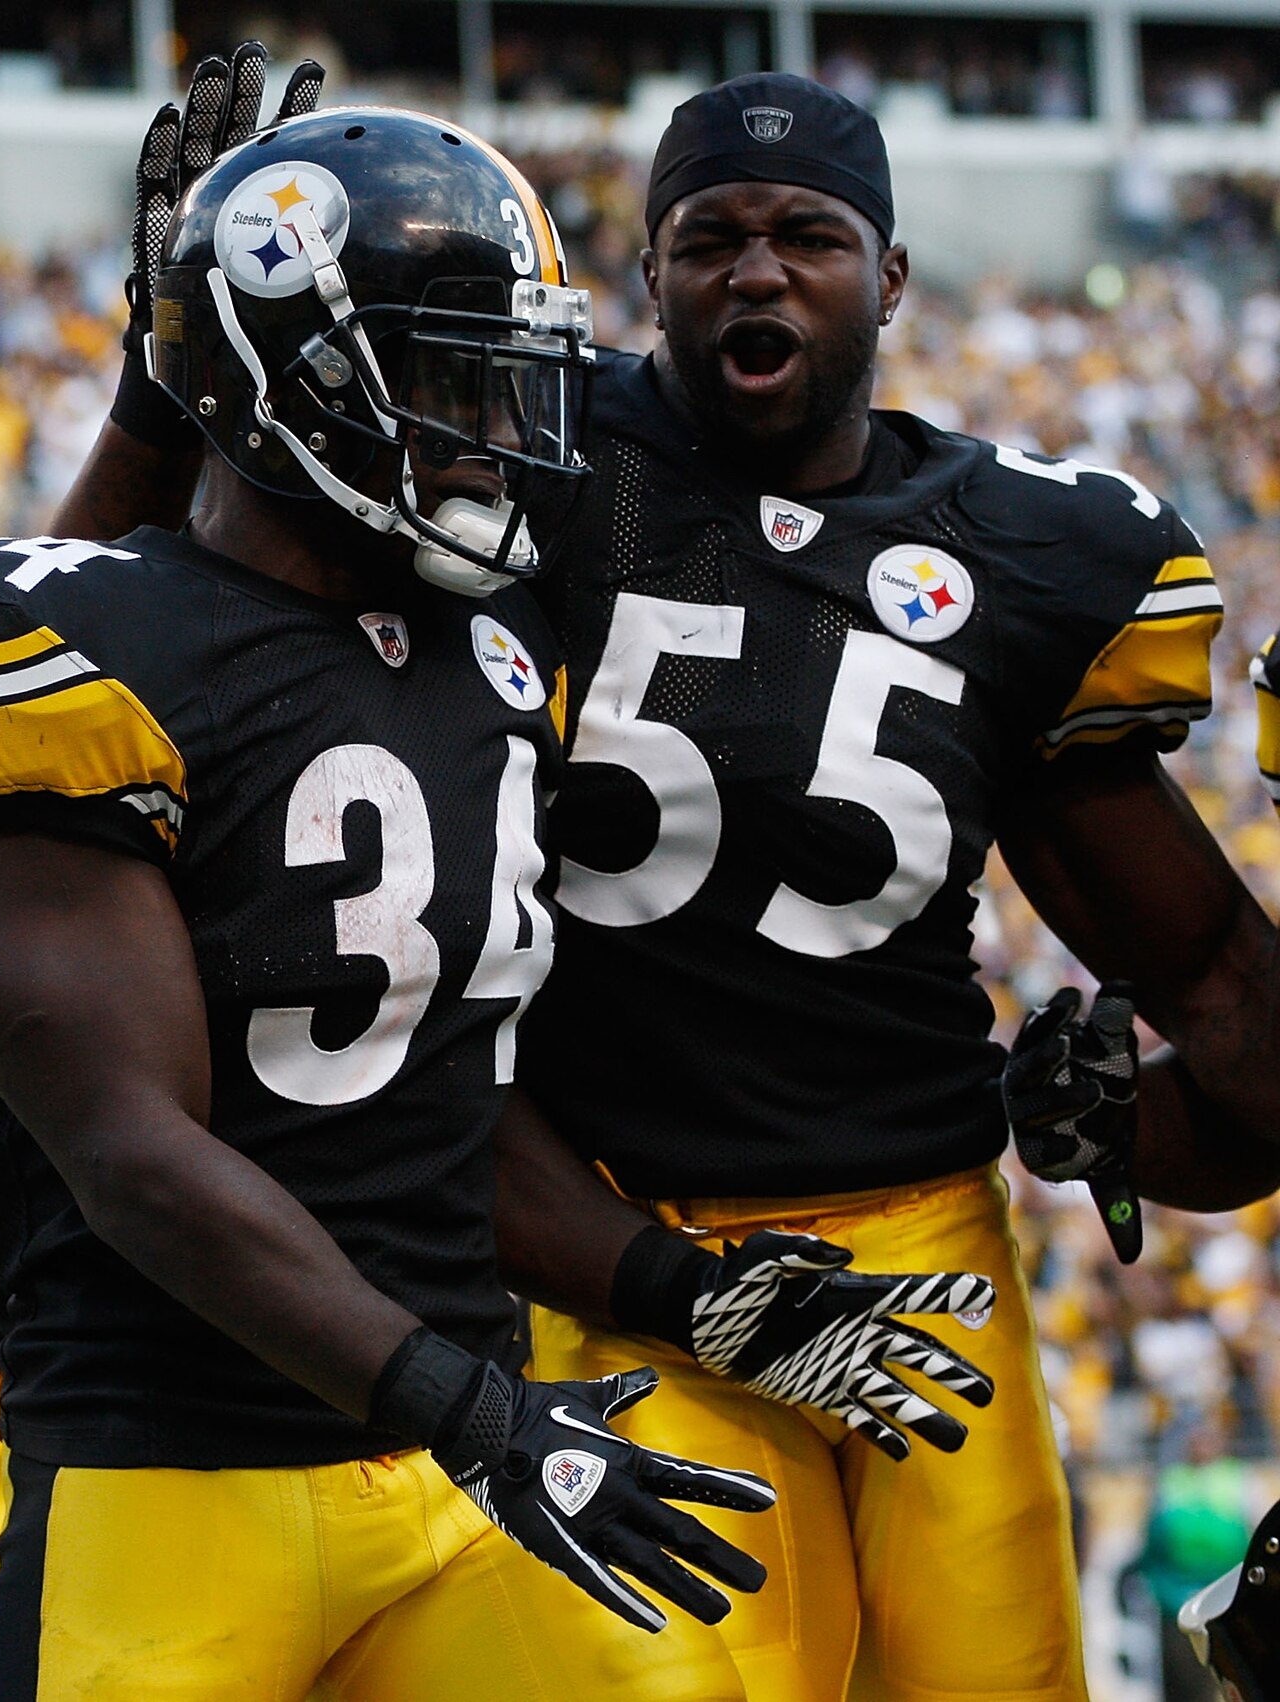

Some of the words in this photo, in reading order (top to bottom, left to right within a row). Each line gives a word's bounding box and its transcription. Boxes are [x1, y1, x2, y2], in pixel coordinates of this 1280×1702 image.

[757, 125, 778, 137] NFL
[232, 210, 273, 228] Steelers
[773, 523, 799, 543] NFL
[879, 571, 919, 593] Steelers
[554, 591, 966, 959] 55
[247, 734, 557, 1106] 34
[553, 1459, 575, 1482] NFL
